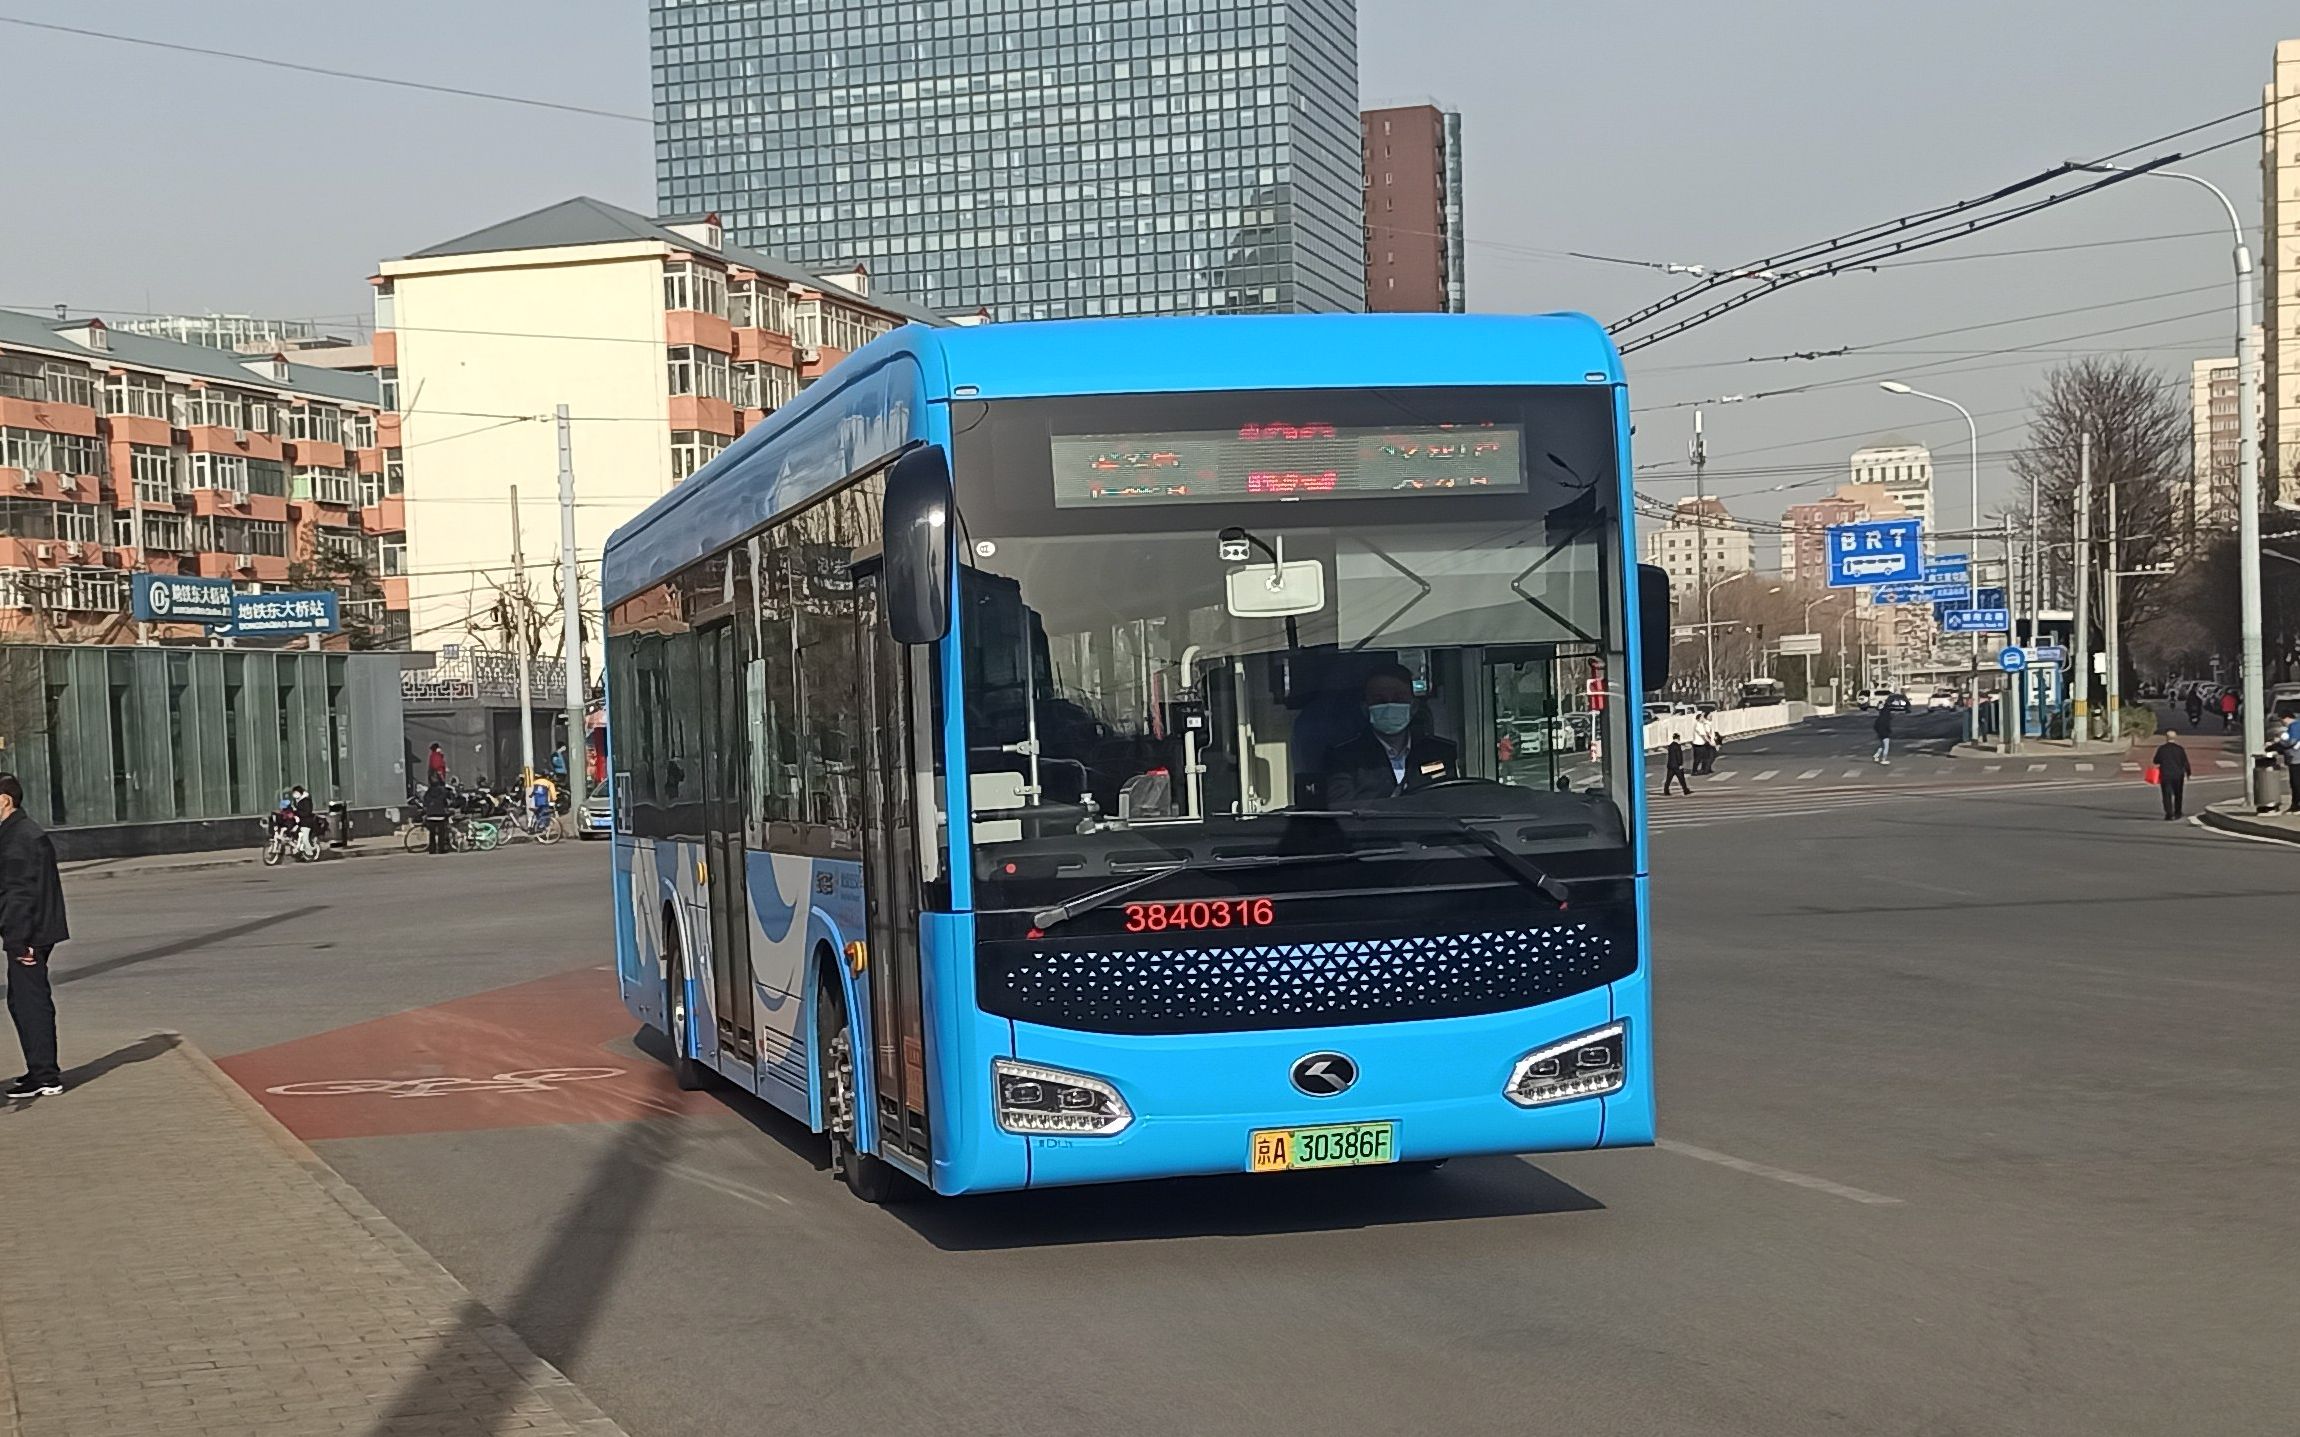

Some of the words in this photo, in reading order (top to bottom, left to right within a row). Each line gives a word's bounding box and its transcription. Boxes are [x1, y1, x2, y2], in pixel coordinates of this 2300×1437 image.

[1841, 528, 1906, 551] BRT
[238, 599, 325, 620] 地铁东大桥站
[1125, 899, 1273, 932] 3840316
[1257, 1137, 1287, 1165] 京A
[1299, 1129, 1389, 1162] 30386F
